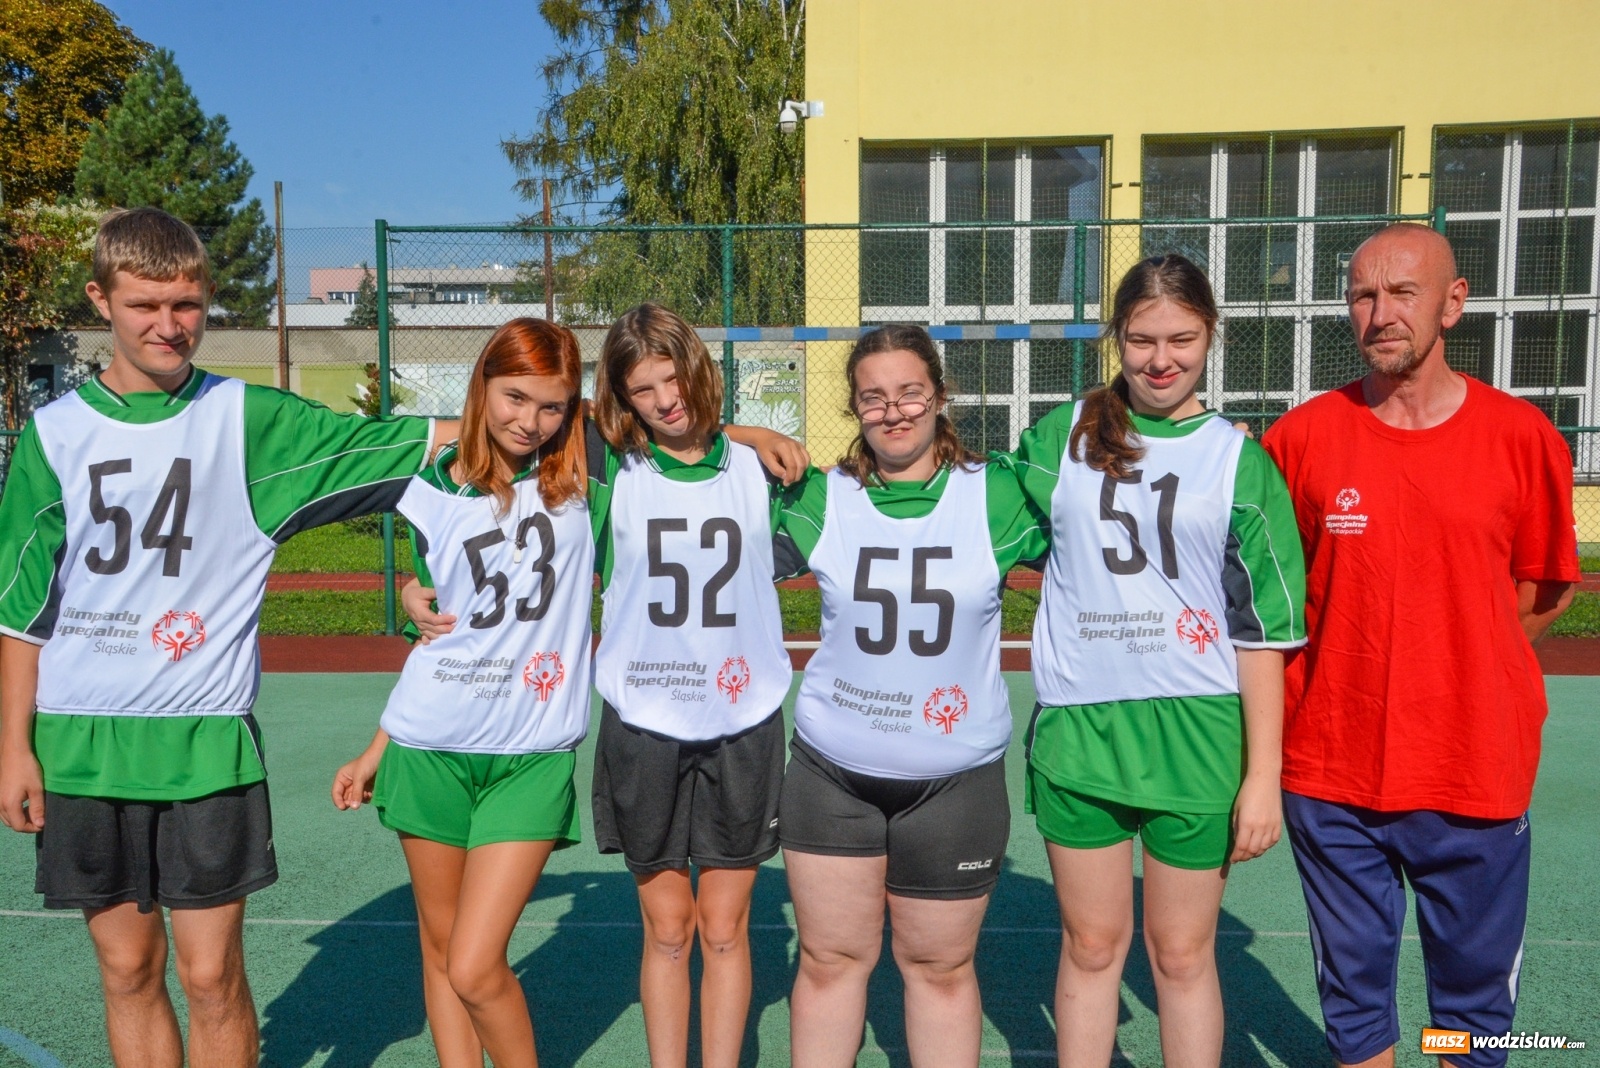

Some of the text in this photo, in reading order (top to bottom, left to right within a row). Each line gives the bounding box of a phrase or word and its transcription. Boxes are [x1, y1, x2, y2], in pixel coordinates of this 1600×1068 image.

[84, 457, 193, 577] 54
[1100, 469, 1180, 580] 51
[462, 511, 556, 630] 53
[647, 517, 742, 628] 52
[853, 546, 955, 657] 55
[62, 606, 142, 625] Olimpady
[1077, 610, 1164, 625] Olimpiady
[1078, 626, 1166, 641] Specjalne
[93, 639, 138, 656] Śląskie
[1125, 640, 1167, 656] Śląskie
[437, 656, 515, 671] Olimpiady
[627, 660, 707, 675] Olimpiady
[432, 669, 513, 685] Specjalne
[625, 674, 707, 688] Specjalne
[473, 685, 512, 700] Śląskie
[670, 688, 707, 704] Śląskie
[833, 677, 913, 706] Olimpiady
[831, 692, 913, 719] Specjalne
[869, 718, 912, 734] Śląskie
